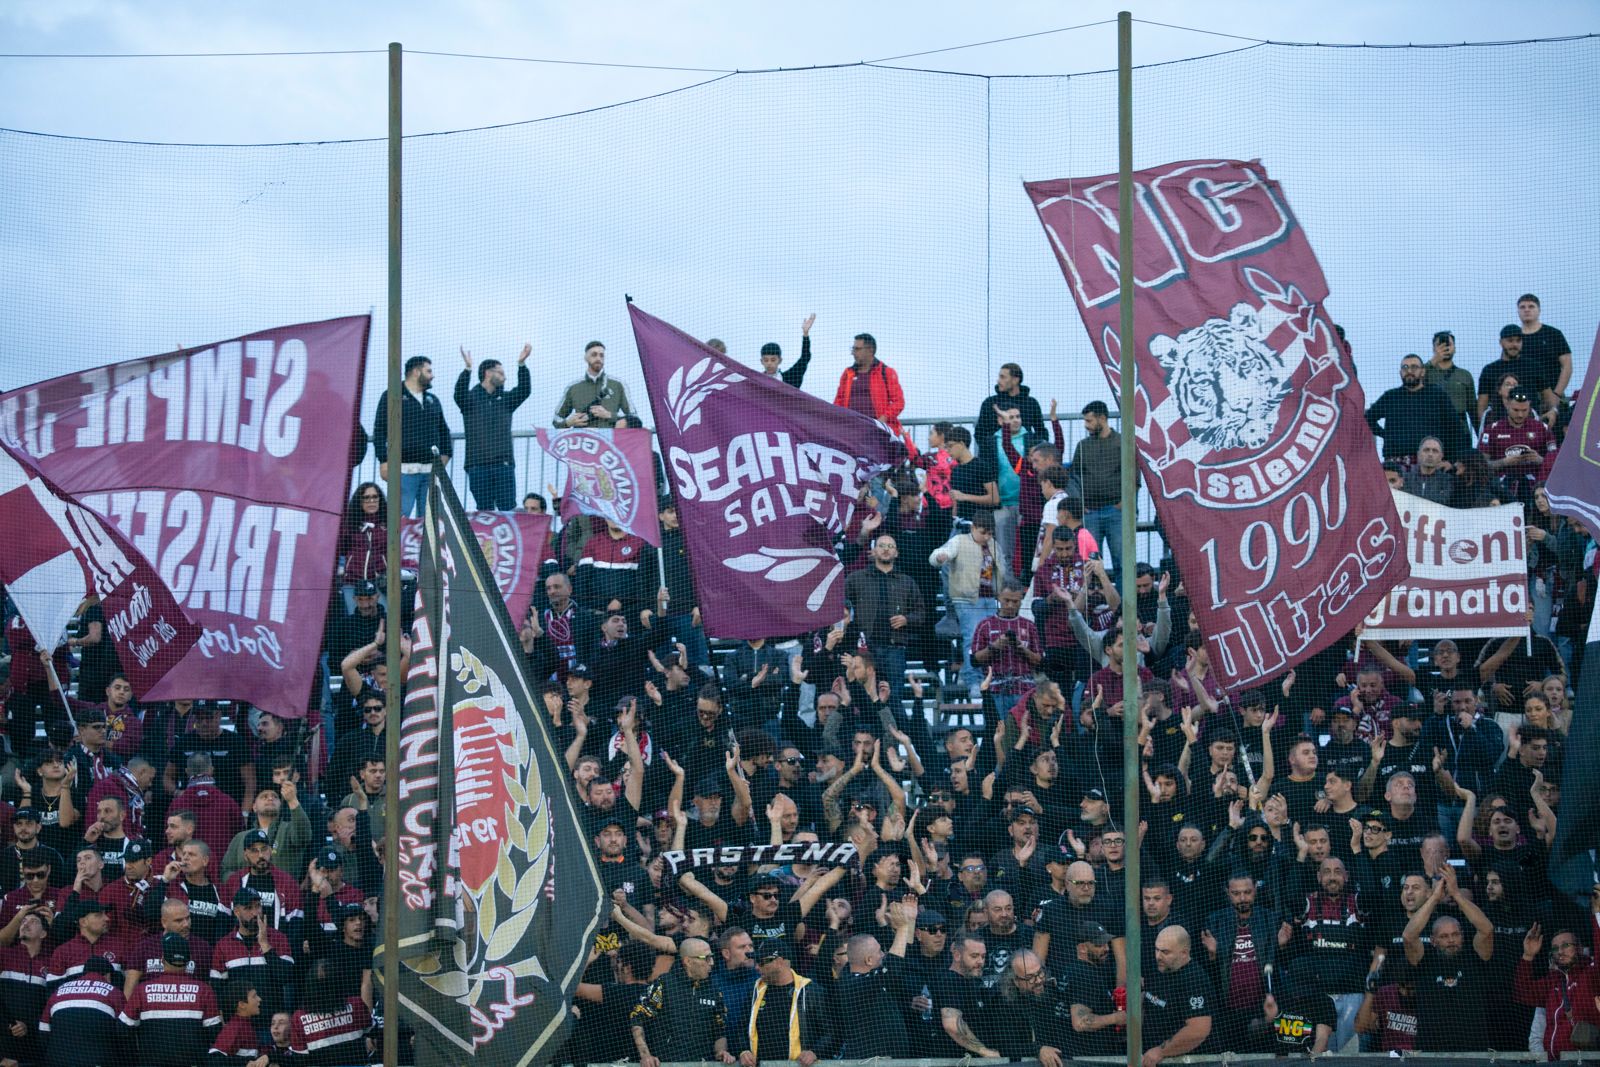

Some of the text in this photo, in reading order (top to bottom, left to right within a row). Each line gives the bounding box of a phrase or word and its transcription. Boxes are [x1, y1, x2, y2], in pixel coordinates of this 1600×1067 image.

[1037, 161, 1296, 309] NG
[1207, 401, 1335, 501] salerno
[1200, 453, 1347, 611] 1990
[1402, 510, 1524, 566] iffoni
[662, 842, 857, 875] PASTENA
[1313, 938, 1348, 949] ellesse
[56, 986, 110, 997] SIBERIANO
[145, 983, 199, 993] CURVA SUD
[147, 993, 196, 1003] SIBERIANO
[303, 1013, 354, 1035] SIBERIANO
[1279, 1018, 1304, 1037] NG
